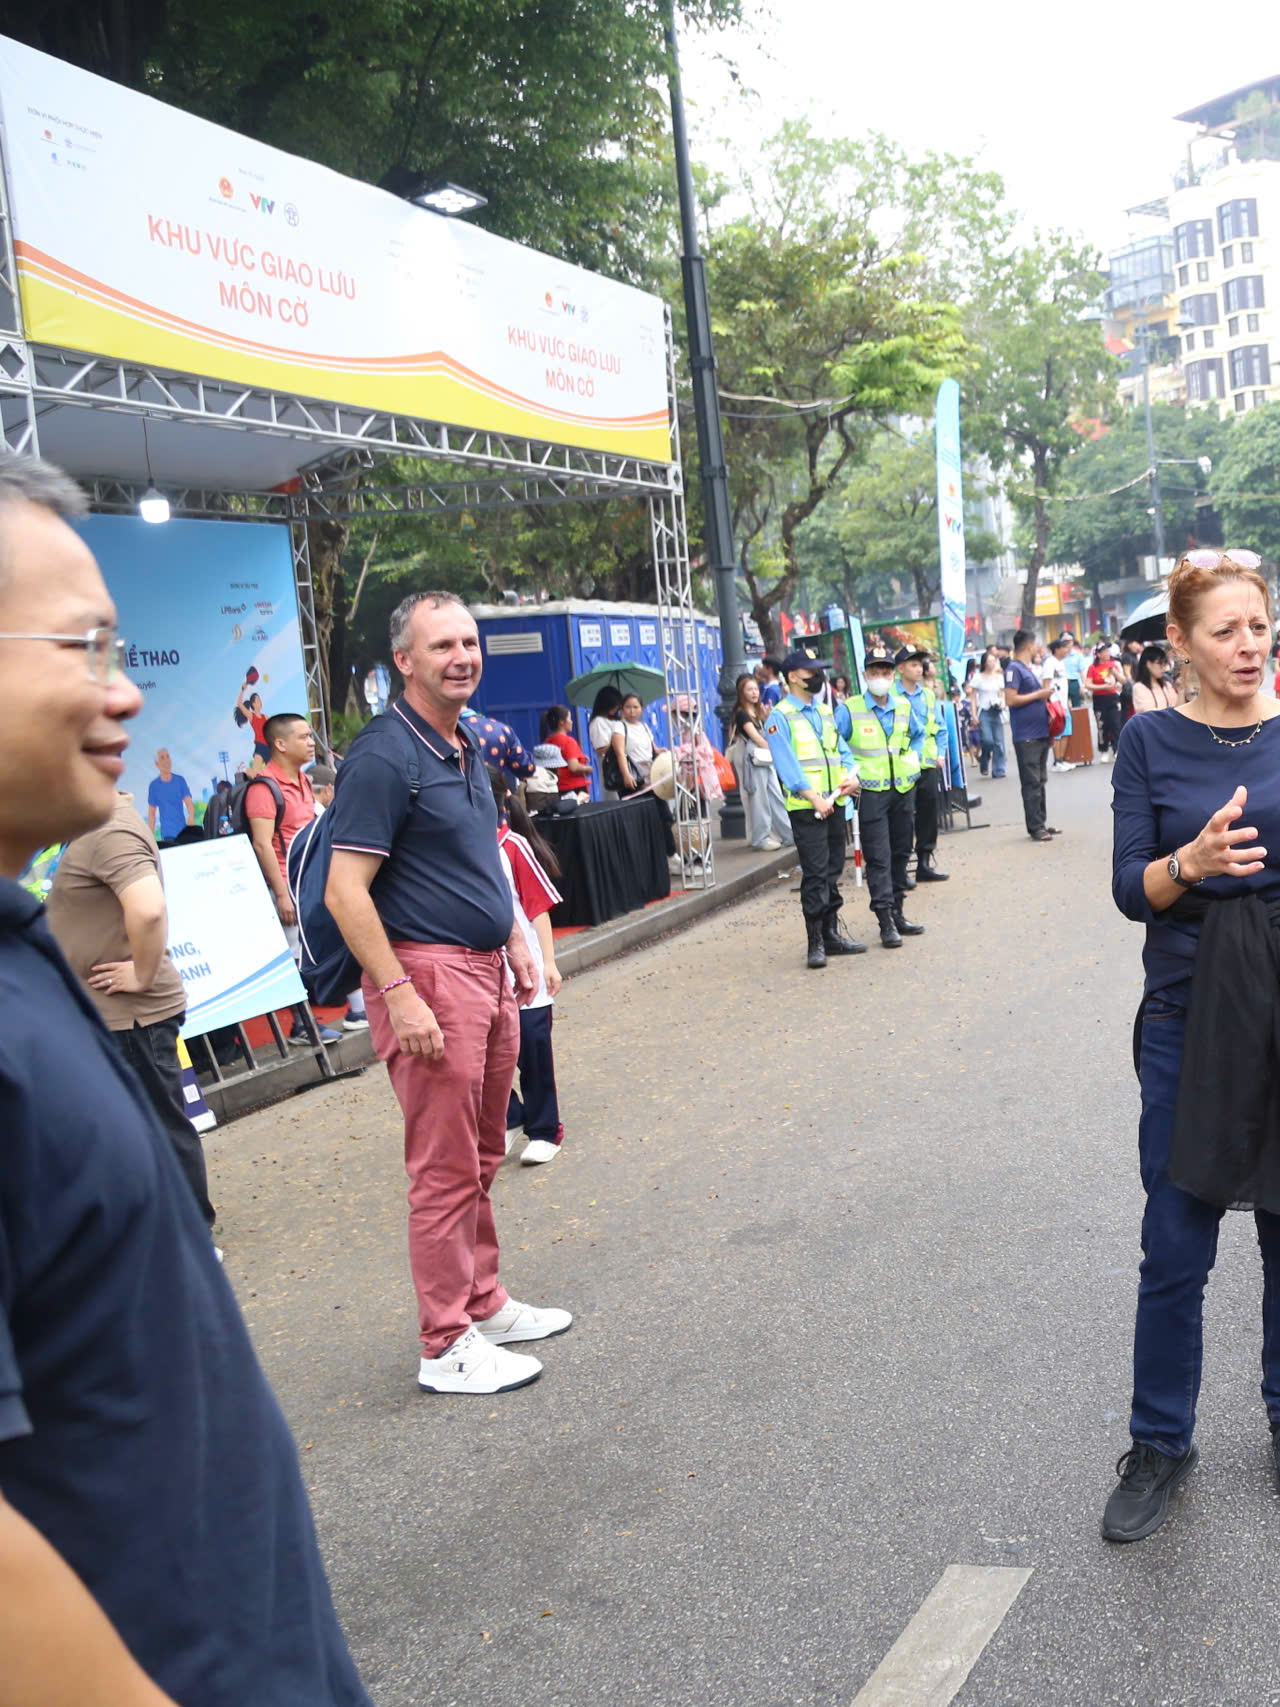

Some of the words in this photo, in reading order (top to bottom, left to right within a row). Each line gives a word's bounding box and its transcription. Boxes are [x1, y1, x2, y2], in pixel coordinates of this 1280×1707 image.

[148, 214, 200, 255] KHU
[206, 232, 255, 271] VỰC
[261, 251, 313, 288] GIAO
[318, 268, 355, 300] LƯU
[219, 280, 272, 319] MÔN
[278, 295, 309, 327] CỜ
[507, 326, 536, 352] KHU
[539, 336, 566, 361] VỰC
[568, 343, 597, 369] GIAO
[545, 367, 575, 393] MÔN
[139, 649, 180, 667] THAO
